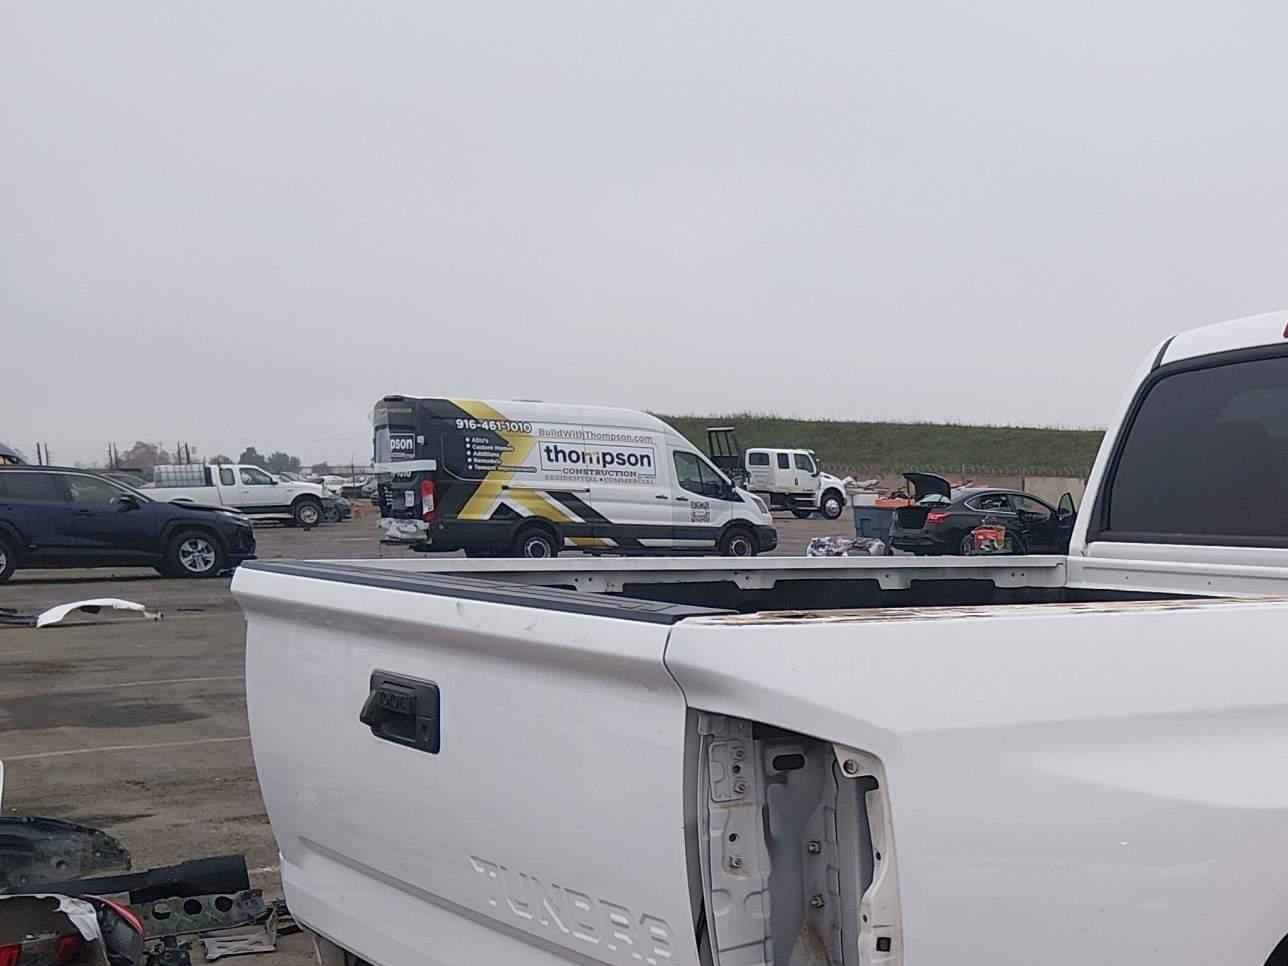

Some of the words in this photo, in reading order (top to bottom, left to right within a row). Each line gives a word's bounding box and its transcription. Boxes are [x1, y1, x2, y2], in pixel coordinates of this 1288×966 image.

[455, 418, 532, 433] 916-461-1010
[538, 428, 653, 443] BuildWithThompson.com
[390, 439, 413, 452] pson
[544, 444, 652, 468] thompson
[562, 468, 637, 478] CONSTRUCTION
